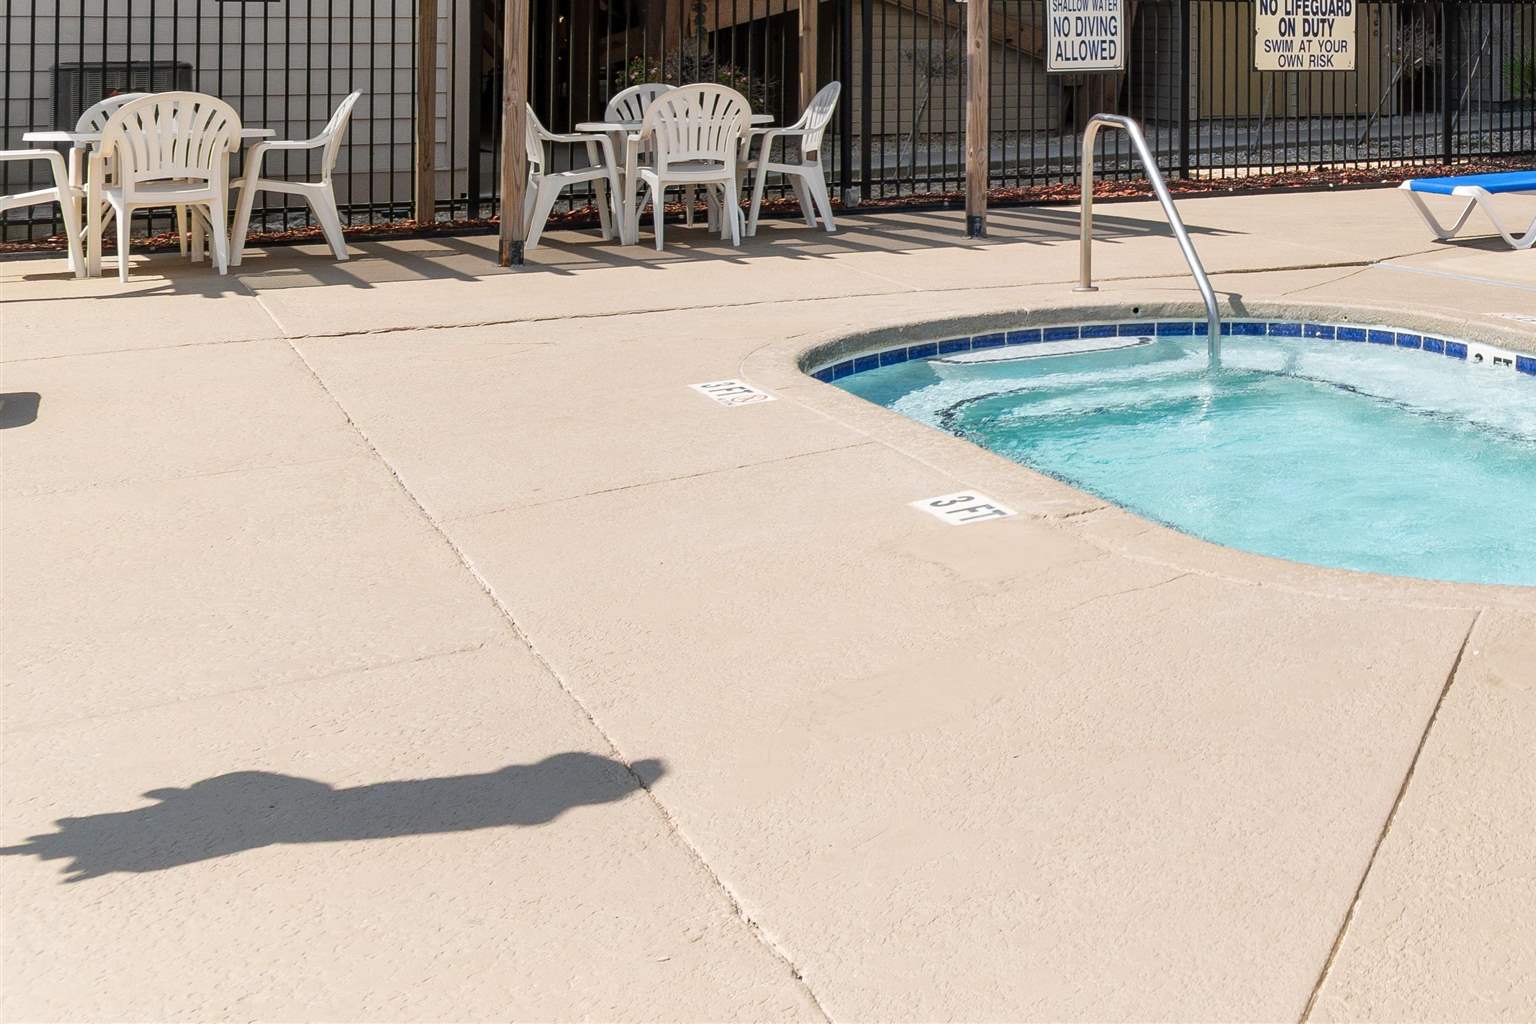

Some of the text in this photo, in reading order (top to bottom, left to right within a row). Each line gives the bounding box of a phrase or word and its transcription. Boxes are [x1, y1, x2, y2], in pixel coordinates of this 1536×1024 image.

[1053, 15, 1118, 38] NO DIVING
[1278, 17, 1335, 38] ON DUTY
[1055, 39, 1117, 62] ALLOWED
[1264, 39, 1348, 53] SWIM AT YOUR
[1278, 54, 1334, 68] OWN RISK
[929, 495, 1008, 522] 3 FT
